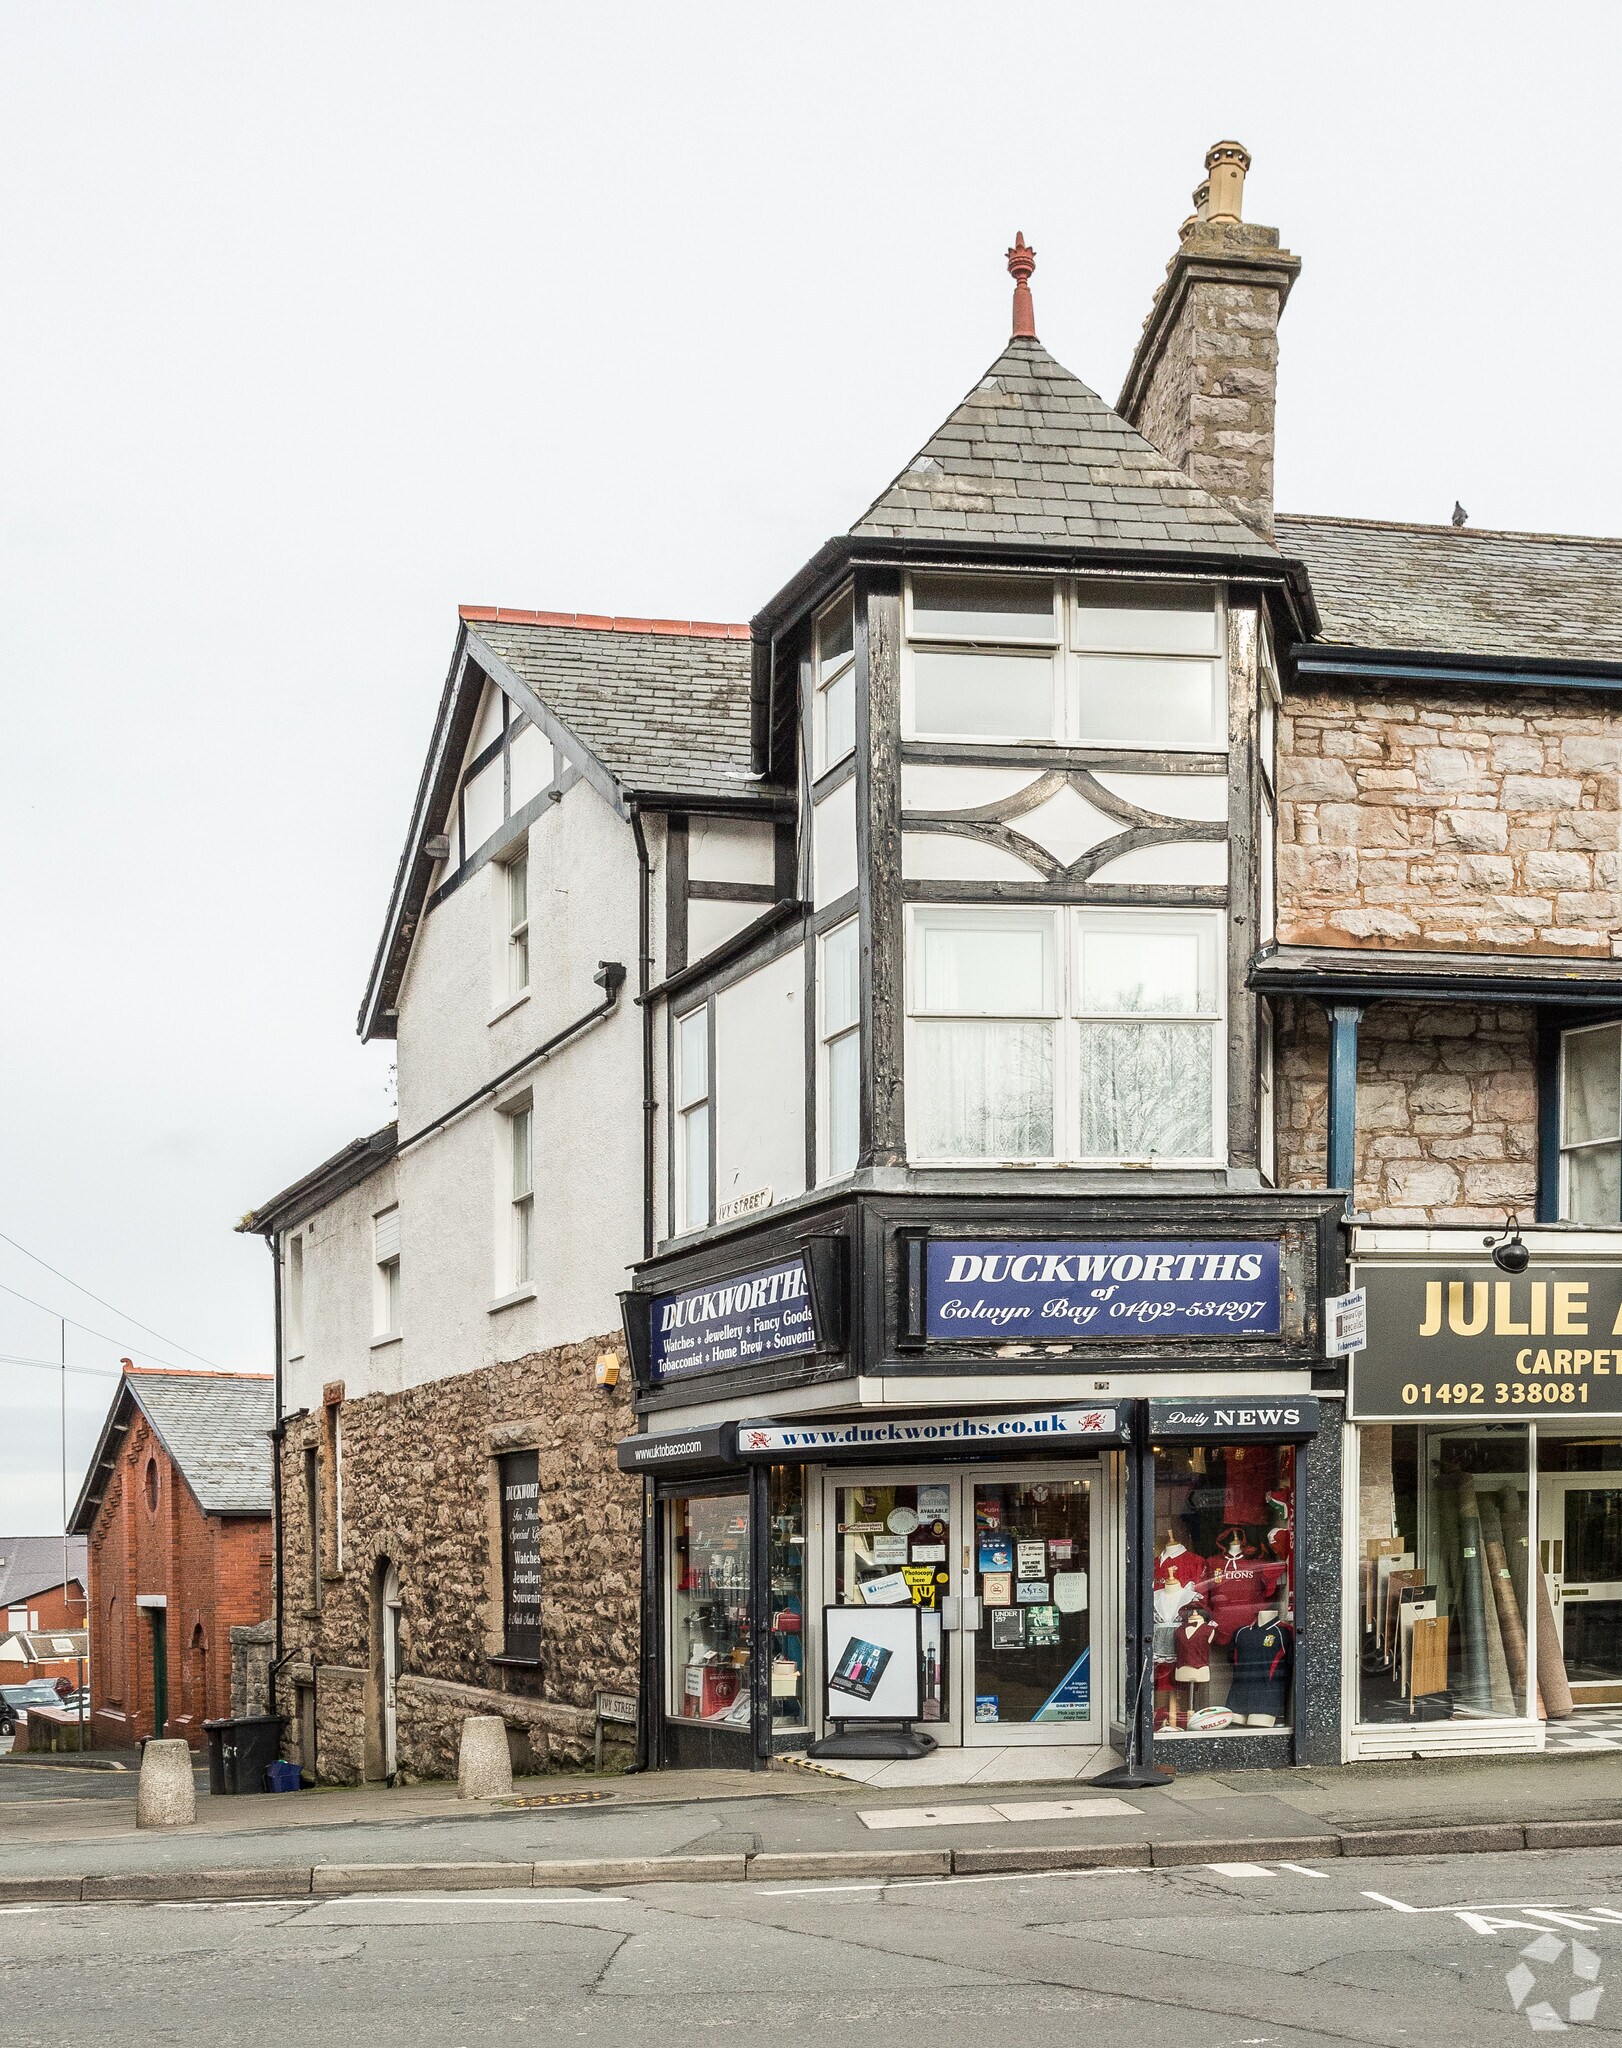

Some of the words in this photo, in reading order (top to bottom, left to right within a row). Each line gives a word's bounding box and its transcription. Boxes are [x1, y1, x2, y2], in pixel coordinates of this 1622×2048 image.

[718, 1204, 731, 1220] IVY
[733, 1191, 766, 1214] STREET
[945, 1253, 1263, 1283] DUCKWORTHS
[1091, 1284, 1119, 1300] of
[939, 1299, 1035, 1326] Colwyn
[1040, 1298, 1100, 1325] Bay
[1109, 1299, 1267, 1323] 01492-531297
[1419, 1281, 1589, 1336] JULIE
[663, 1334, 695, 1354] Watches
[704, 1324, 743, 1344] Jewellery
[754, 1313, 780, 1333] Fancy
[783, 1305, 813, 1326] Goods
[1343, 1320, 1364, 1335] specialist
[657, 1352, 703, 1373] Tobacconist
[712, 1345, 737, 1362] Home
[740, 1339, 763, 1356] Brew
[1515, 1348, 1622, 1375] CARPET
[1402, 1383, 1485, 1404] 01492
[1495, 1383, 1589, 1404] 338081
[781, 1414, 1068, 1446] www.duckworths.co.uk
[1166, 1410, 1210, 1427] Daily
[1213, 1409, 1300, 1427] NEWS
[634, 1440, 702, 1461] www.uktobacco.com
[514, 1550, 541, 1564] Watches
[1225, 1570, 1254, 1579] LIONS
[601, 1698, 612, 1711] IVY
[614, 1700, 636, 1716] STREET
